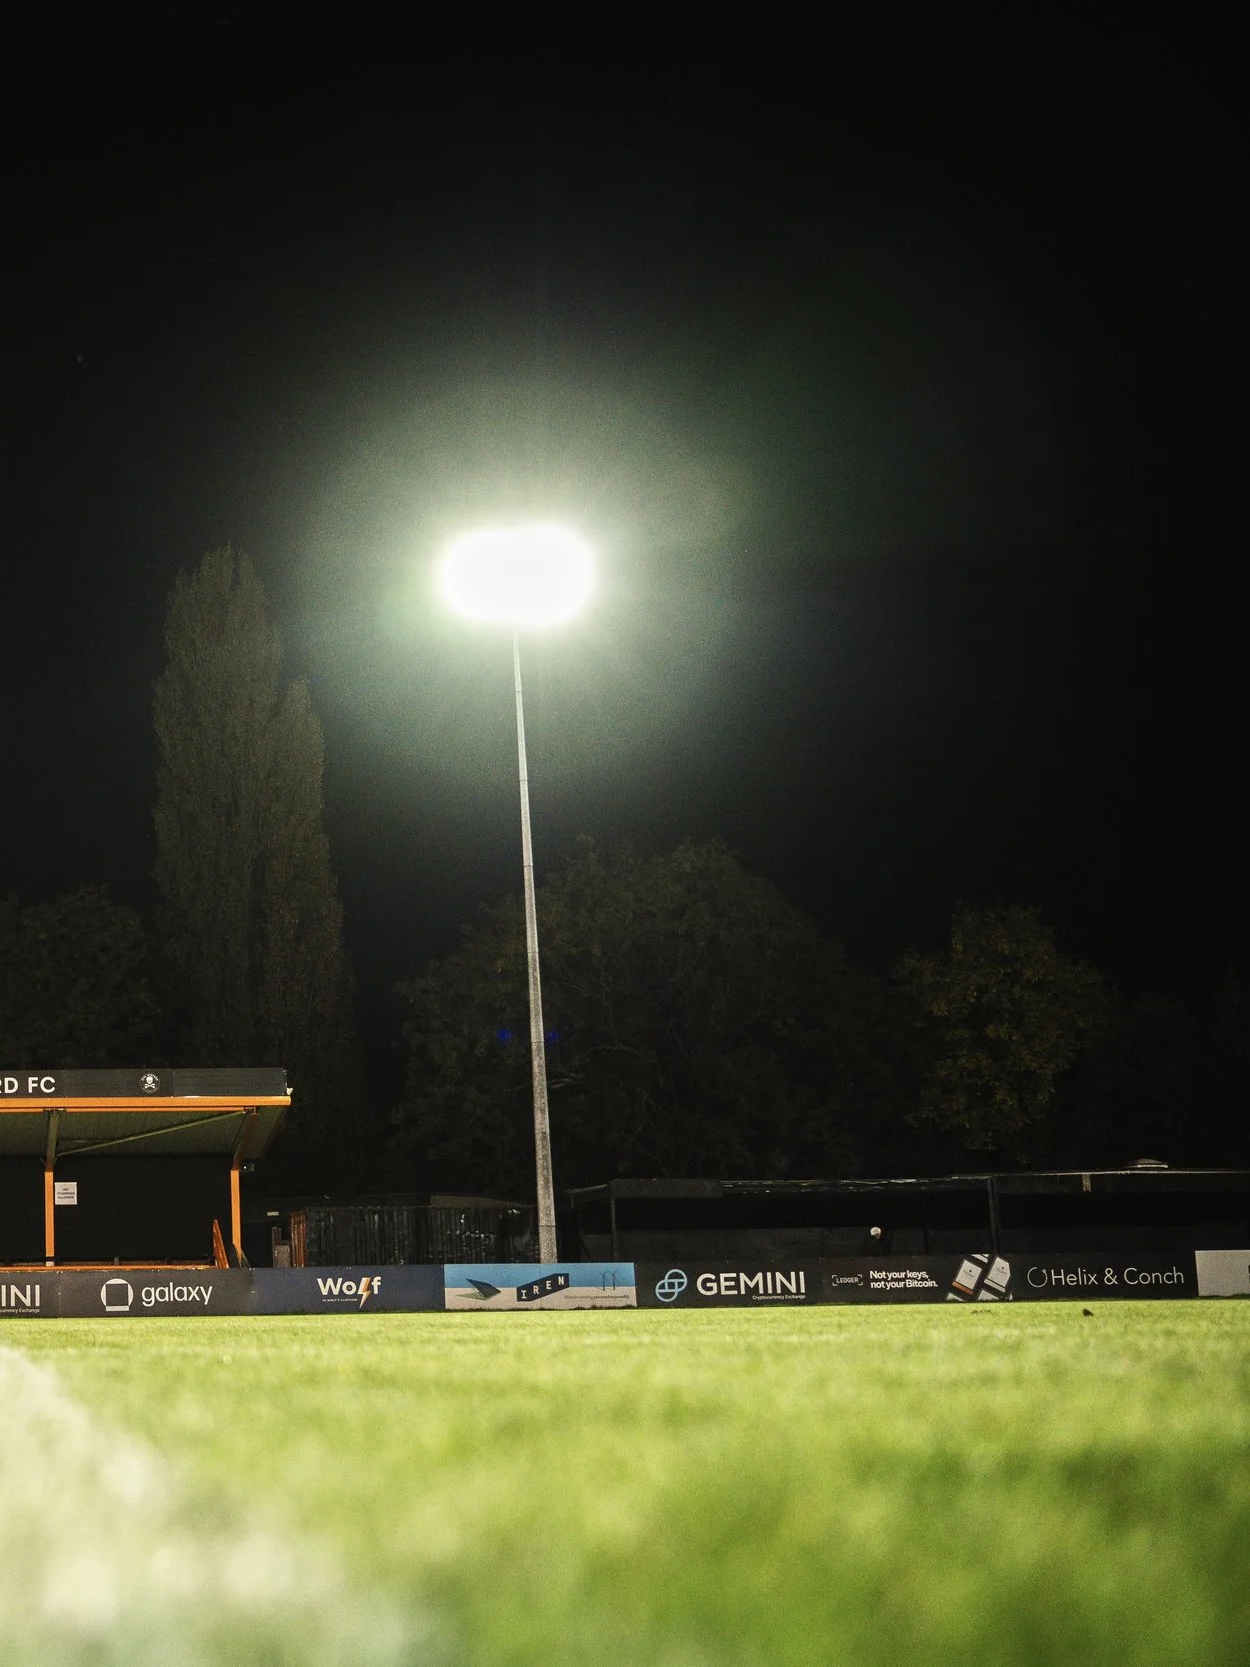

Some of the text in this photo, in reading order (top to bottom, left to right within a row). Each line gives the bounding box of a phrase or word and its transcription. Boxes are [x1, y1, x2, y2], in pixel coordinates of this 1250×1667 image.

[28, 1076, 56, 1094] FC
[696, 1271, 806, 1296] GEMINI
[836, 1276, 859, 1284] LEDGER
[869, 1269, 929, 1280] Not your keys,
[1051, 1266, 1184, 1286] Helix & Conch
[141, 1281, 213, 1307] galaxy
[521, 1276, 565, 1299] IREN
[870, 1279, 938, 1290] not your Bitcoin.
